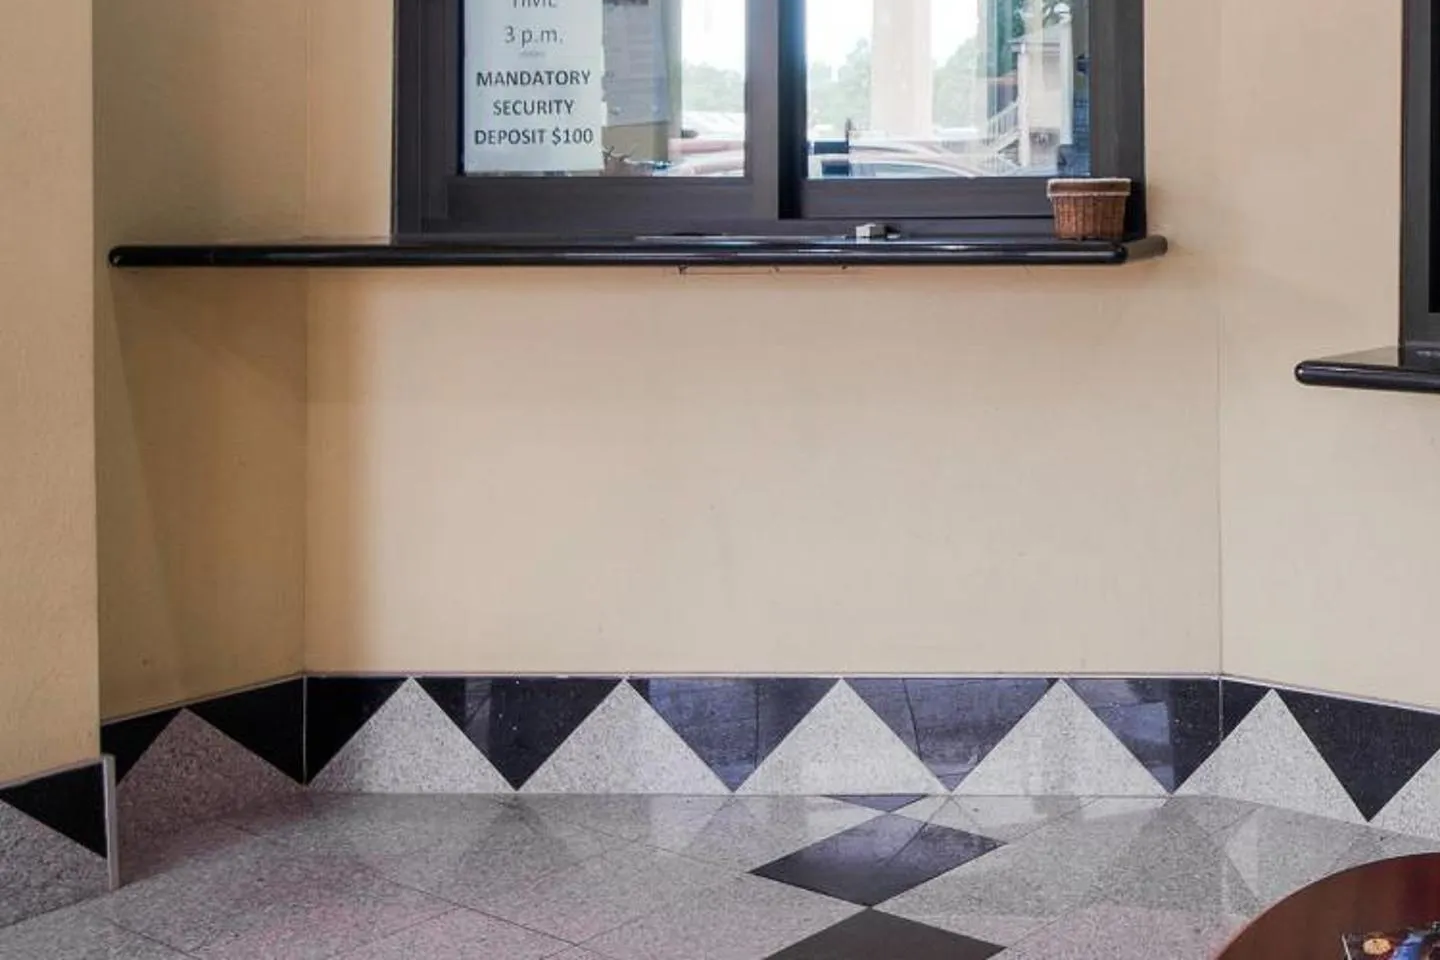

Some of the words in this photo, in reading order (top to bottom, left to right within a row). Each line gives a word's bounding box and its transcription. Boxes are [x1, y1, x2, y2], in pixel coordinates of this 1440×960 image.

[504, 25, 516, 44] 3
[521, 28, 564, 48] p.m.
[476, 70, 591, 87] MANDATORY
[493, 99, 575, 116] SECURITY
[474, 129, 547, 146] DEPOSIT
[552, 128, 594, 147] $100
